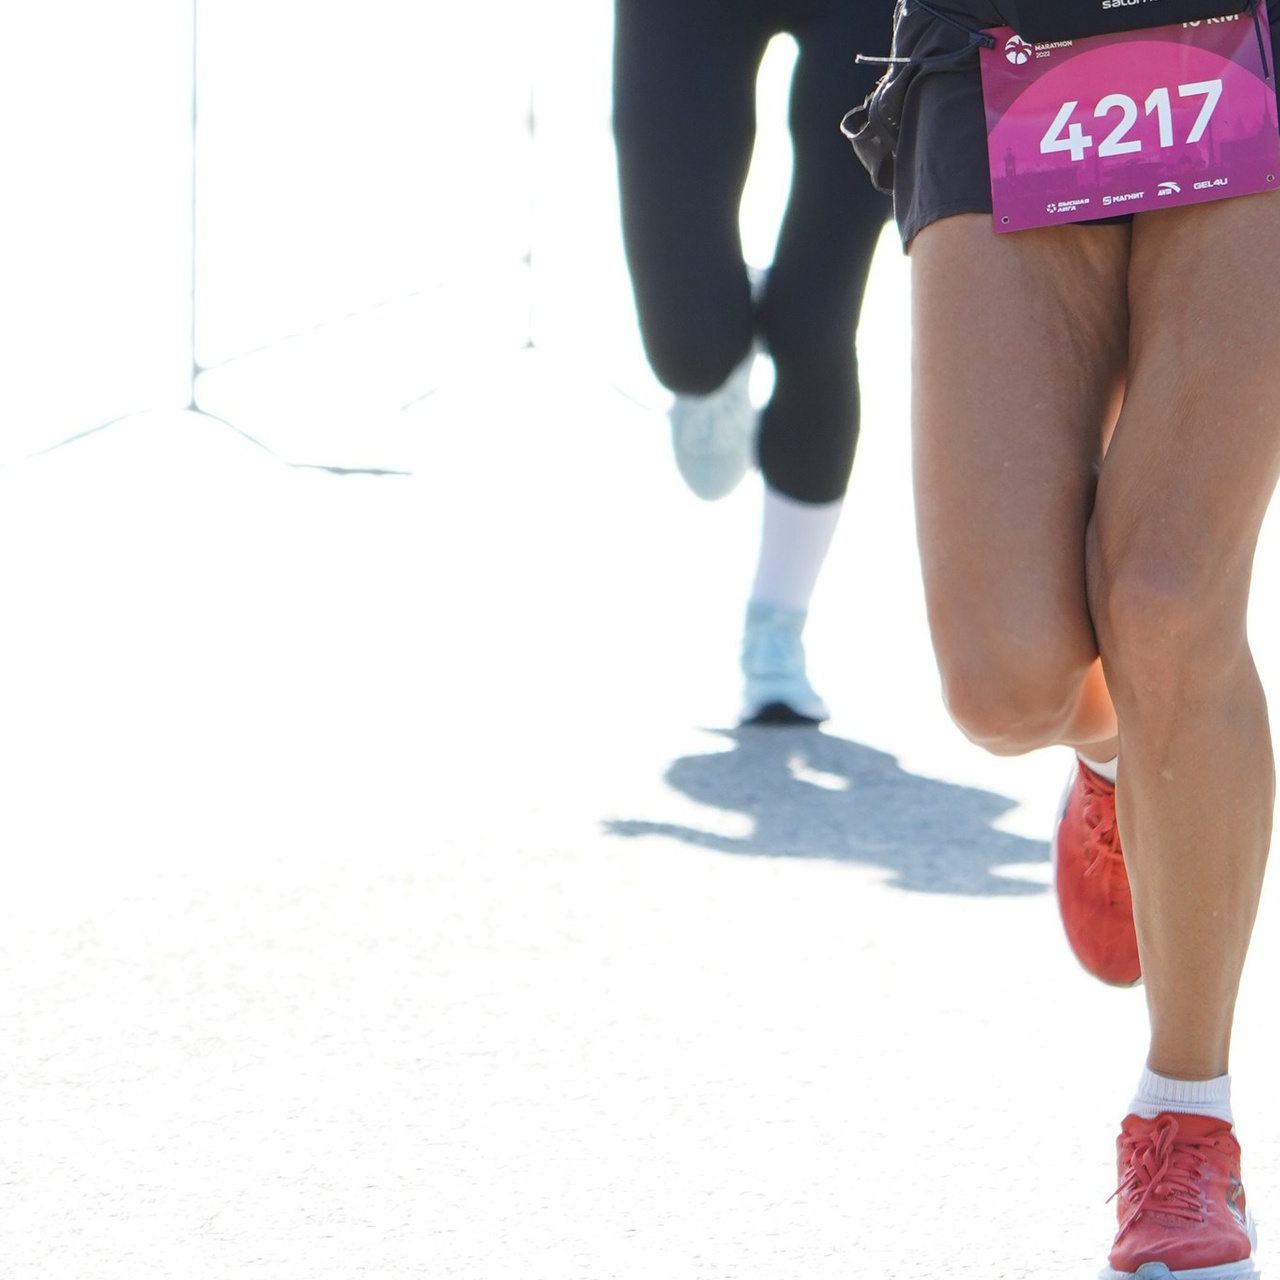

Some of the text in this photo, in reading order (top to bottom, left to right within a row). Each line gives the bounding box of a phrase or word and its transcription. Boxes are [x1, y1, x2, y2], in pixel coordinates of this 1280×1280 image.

[1034, 40, 1073, 51] MARATHON
[1035, 51, 1051, 59] 2022
[1039, 78, 1223, 162] 4217
[1192, 178, 1228, 190] GEL4U
[1112, 191, 1145, 203] МАГНИТ
